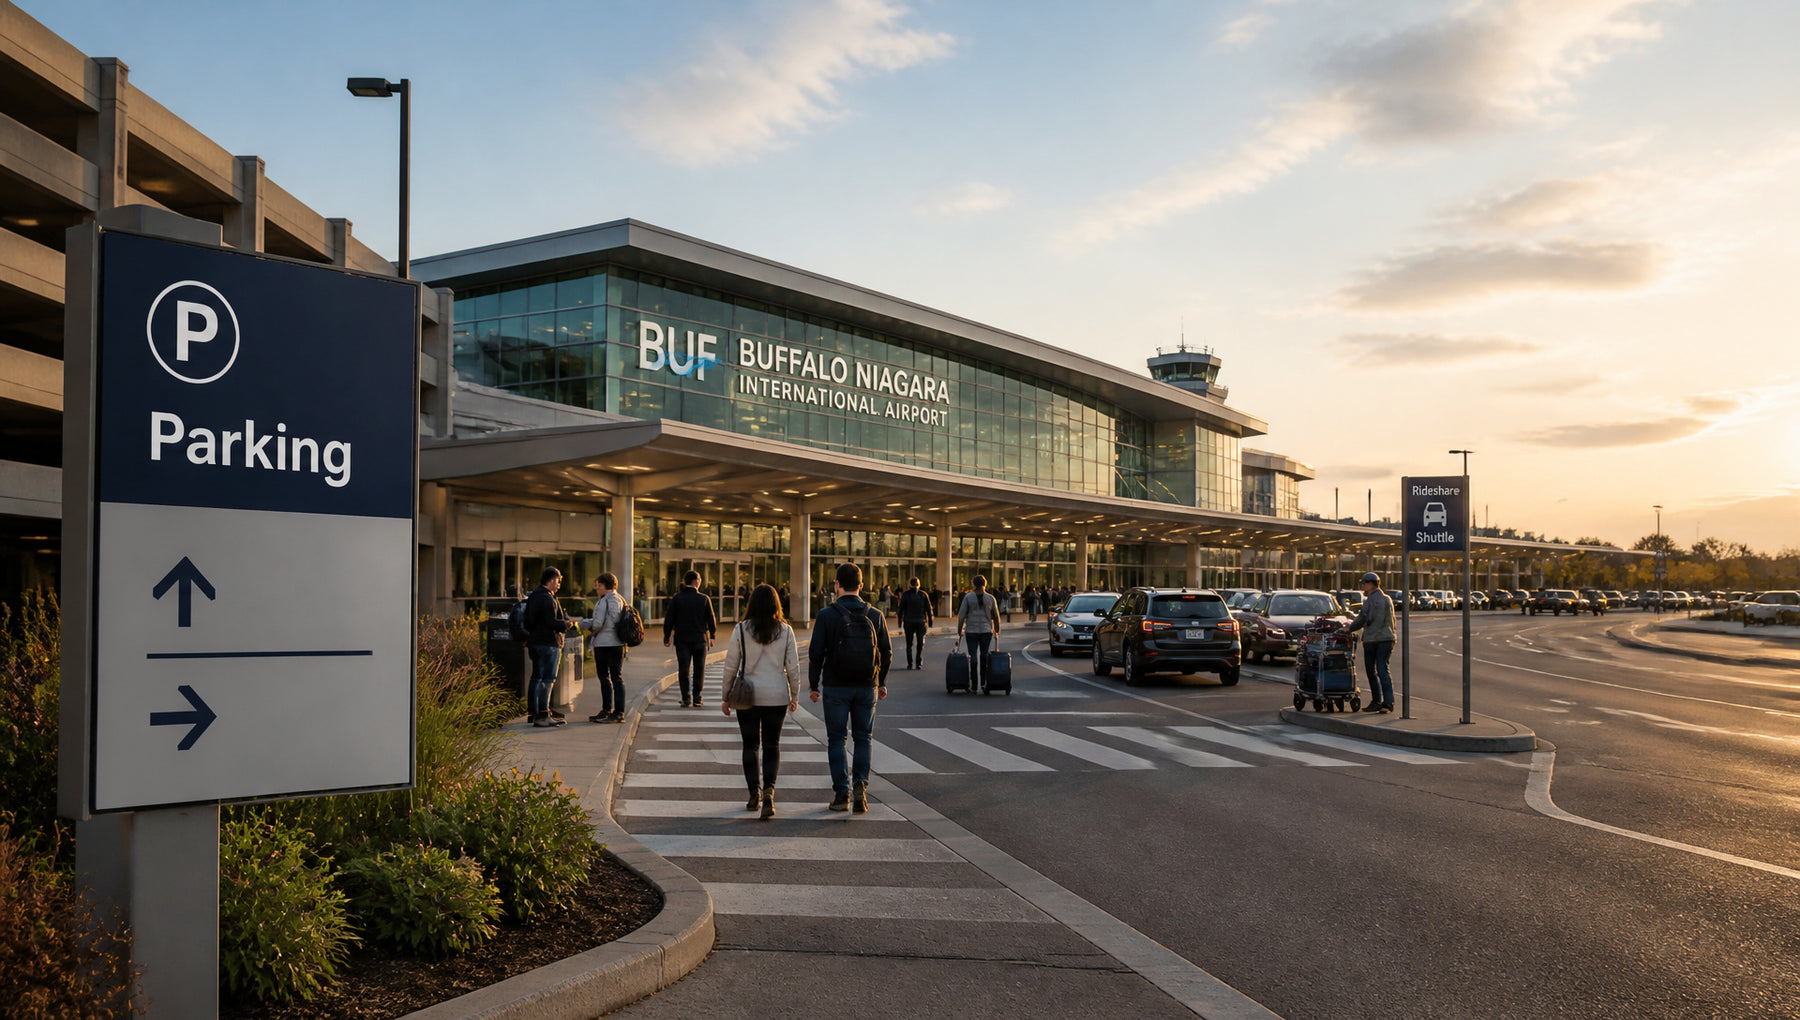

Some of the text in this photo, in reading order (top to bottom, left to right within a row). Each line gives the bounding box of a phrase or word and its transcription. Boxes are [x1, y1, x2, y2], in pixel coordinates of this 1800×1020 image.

[176, 300, 218, 361] P
[639, 320, 717, 381] BUF
[738, 338, 950, 404] BUFFALO NIAGARA
[738, 375, 948, 427] INTERNATIONAL AIRPORT
[151, 411, 352, 488] Parking
[1412, 485, 1460, 496] Rideshare
[1416, 531, 1455, 544] Shuttle
